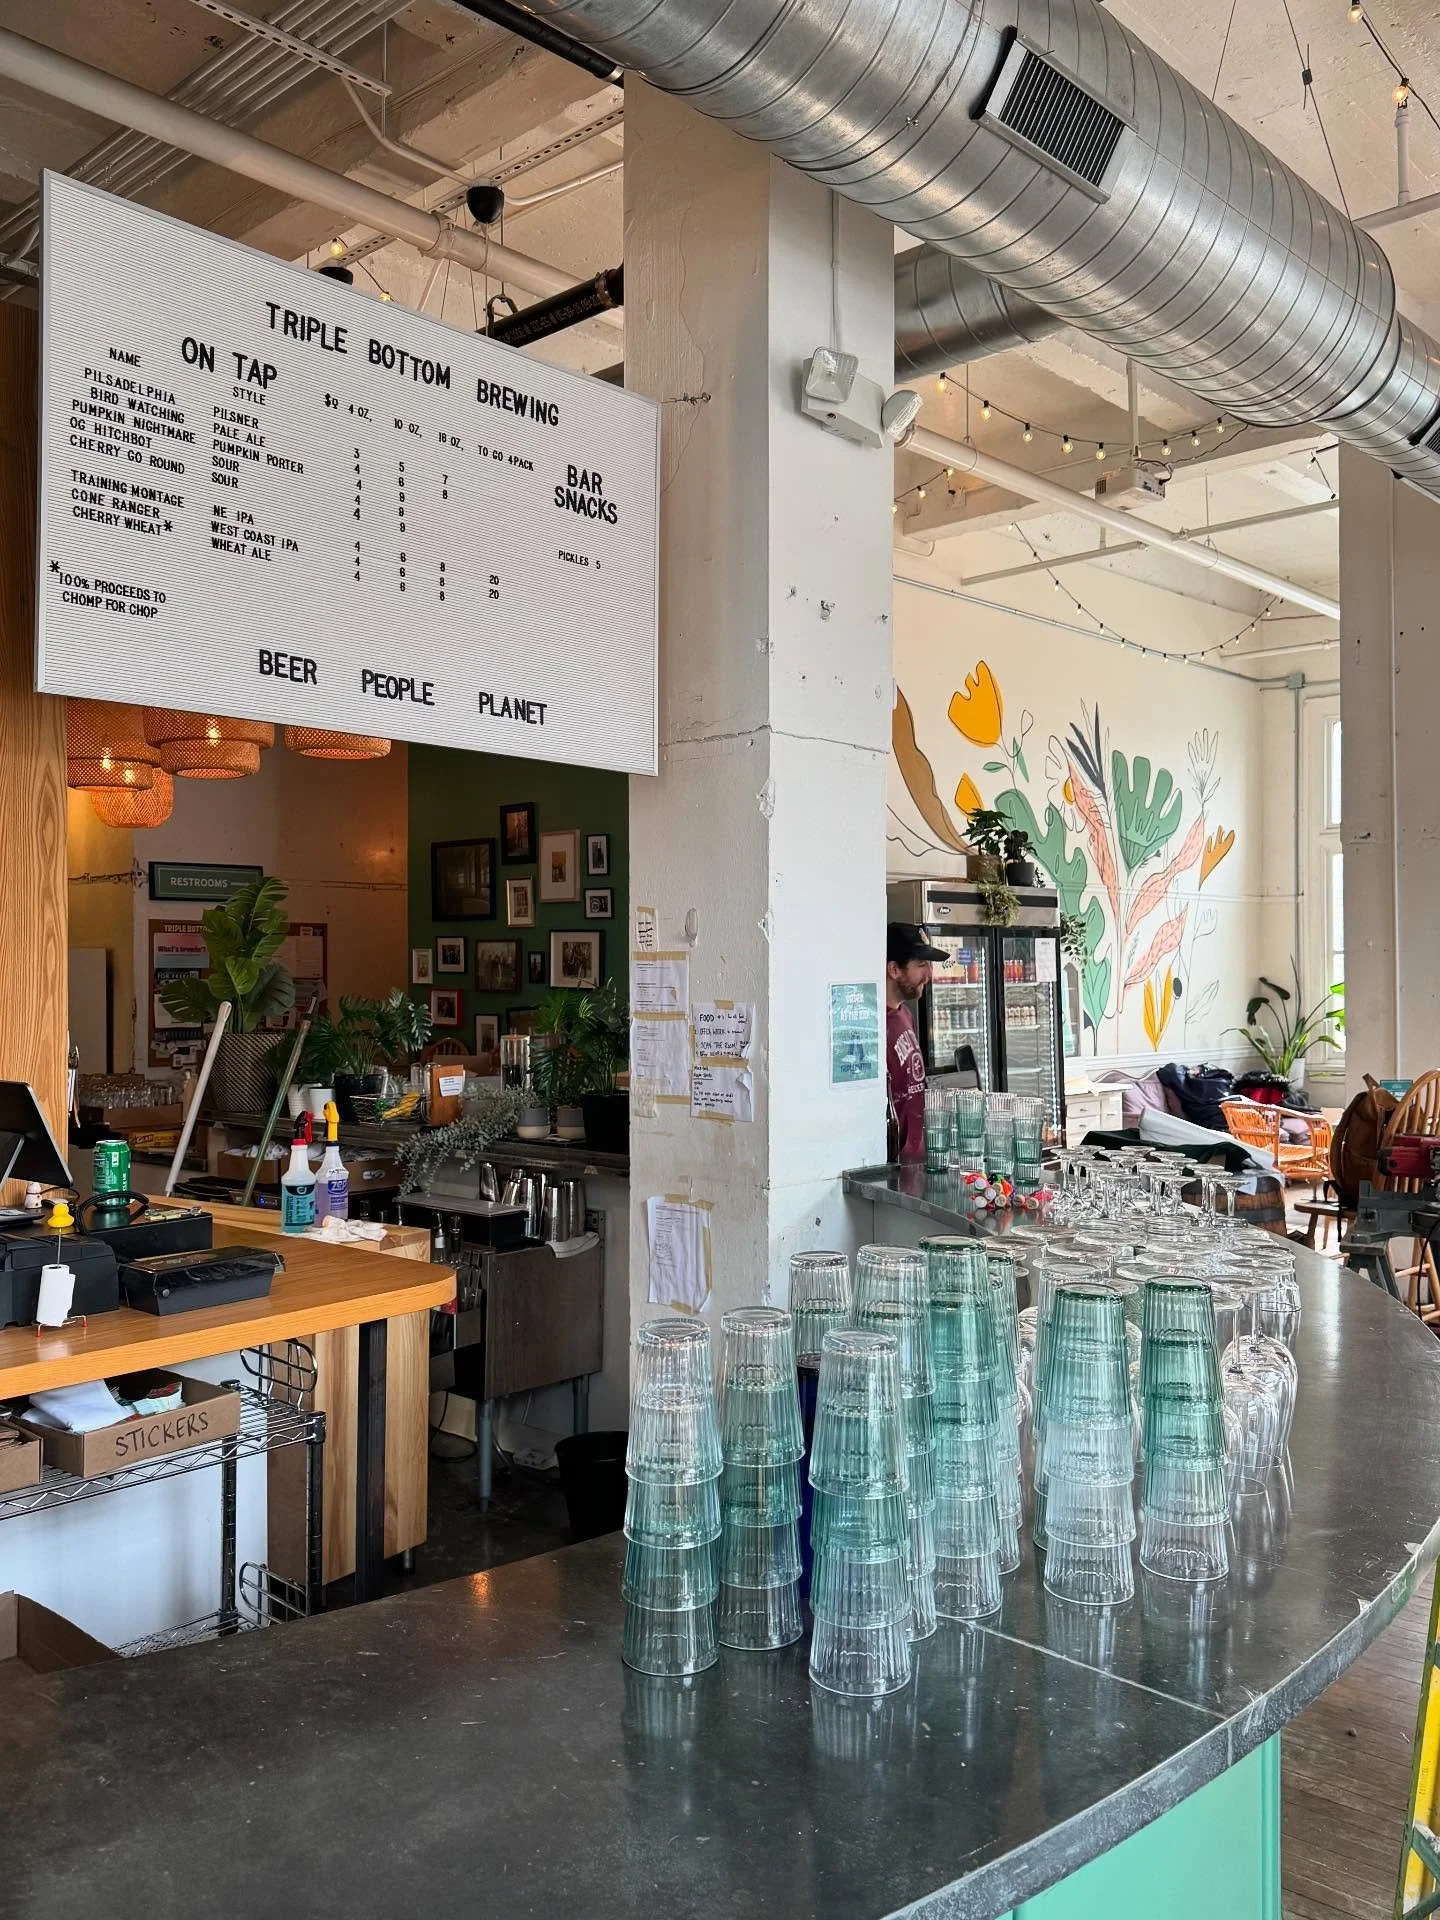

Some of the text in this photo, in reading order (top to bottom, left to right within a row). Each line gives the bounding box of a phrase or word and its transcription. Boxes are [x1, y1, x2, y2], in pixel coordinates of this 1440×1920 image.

[109, 347, 141, 367] NAME
[182, 337, 277, 389] ON TAP
[266, 301, 559, 426] TRIPLE BOTTOM BREWING
[84, 367, 176, 405] PILSADELPHIA
[233, 387, 266, 405] STYLE
[90, 386, 184, 424] BIRD WATCHING
[213, 406, 259, 429] PILSNER
[70, 416, 152, 449] OG HITCHBOT
[72, 399, 196, 444] PUMPKIN NIGHTMARE
[213, 422, 266, 447] PALE ALE
[348, 404, 354, 414] 4
[394, 418, 403, 429] 10
[478, 445, 488, 456] TO
[493, 450, 503, 461] GO
[70, 434, 184, 474] CHERRY GO ROUND
[212, 456, 239, 472] SOUR
[213, 439, 304, 474] PUMPKIN PORTER
[354, 448, 448, 484] 3 5 7
[71, 469, 185, 508] TRAINING MONTAGE
[212, 472, 238, 488] SOUR
[354, 464, 360, 474] 4
[442, 489, 448, 499] 8
[356, 479, 362, 490] 4
[554, 464, 618, 524] BAR SNACKS
[71, 488, 160, 519] CONE RANGER
[213, 504, 254, 525] NE IPA
[353, 508, 360, 520] 4
[355, 495, 360, 505] 4
[73, 506, 120, 526] CHERRY
[211, 521, 298, 552] WEST COAST IPA
[211, 537, 272, 561] WHEAT ALE
[354, 541, 360, 552] 4
[400, 552, 406, 562] 6
[489, 575, 499, 585] 20
[558, 550, 601, 569] PICKLES 5
[94, 579, 150, 601] PROCEEDS
[153, 590, 166, 603] TO
[354, 571, 445, 601] 4 6 8
[355, 556, 499, 599] 4 6 8 20
[62, 591, 158, 618] CHOMP FOR CHOP
[259, 649, 547, 726] BEER PEOPLE PLANET
[170, 876, 228, 889] RESTROOMS
[700, 1014, 714, 1022] FOOD
[115, 1411, 209, 1457] STICKERS
